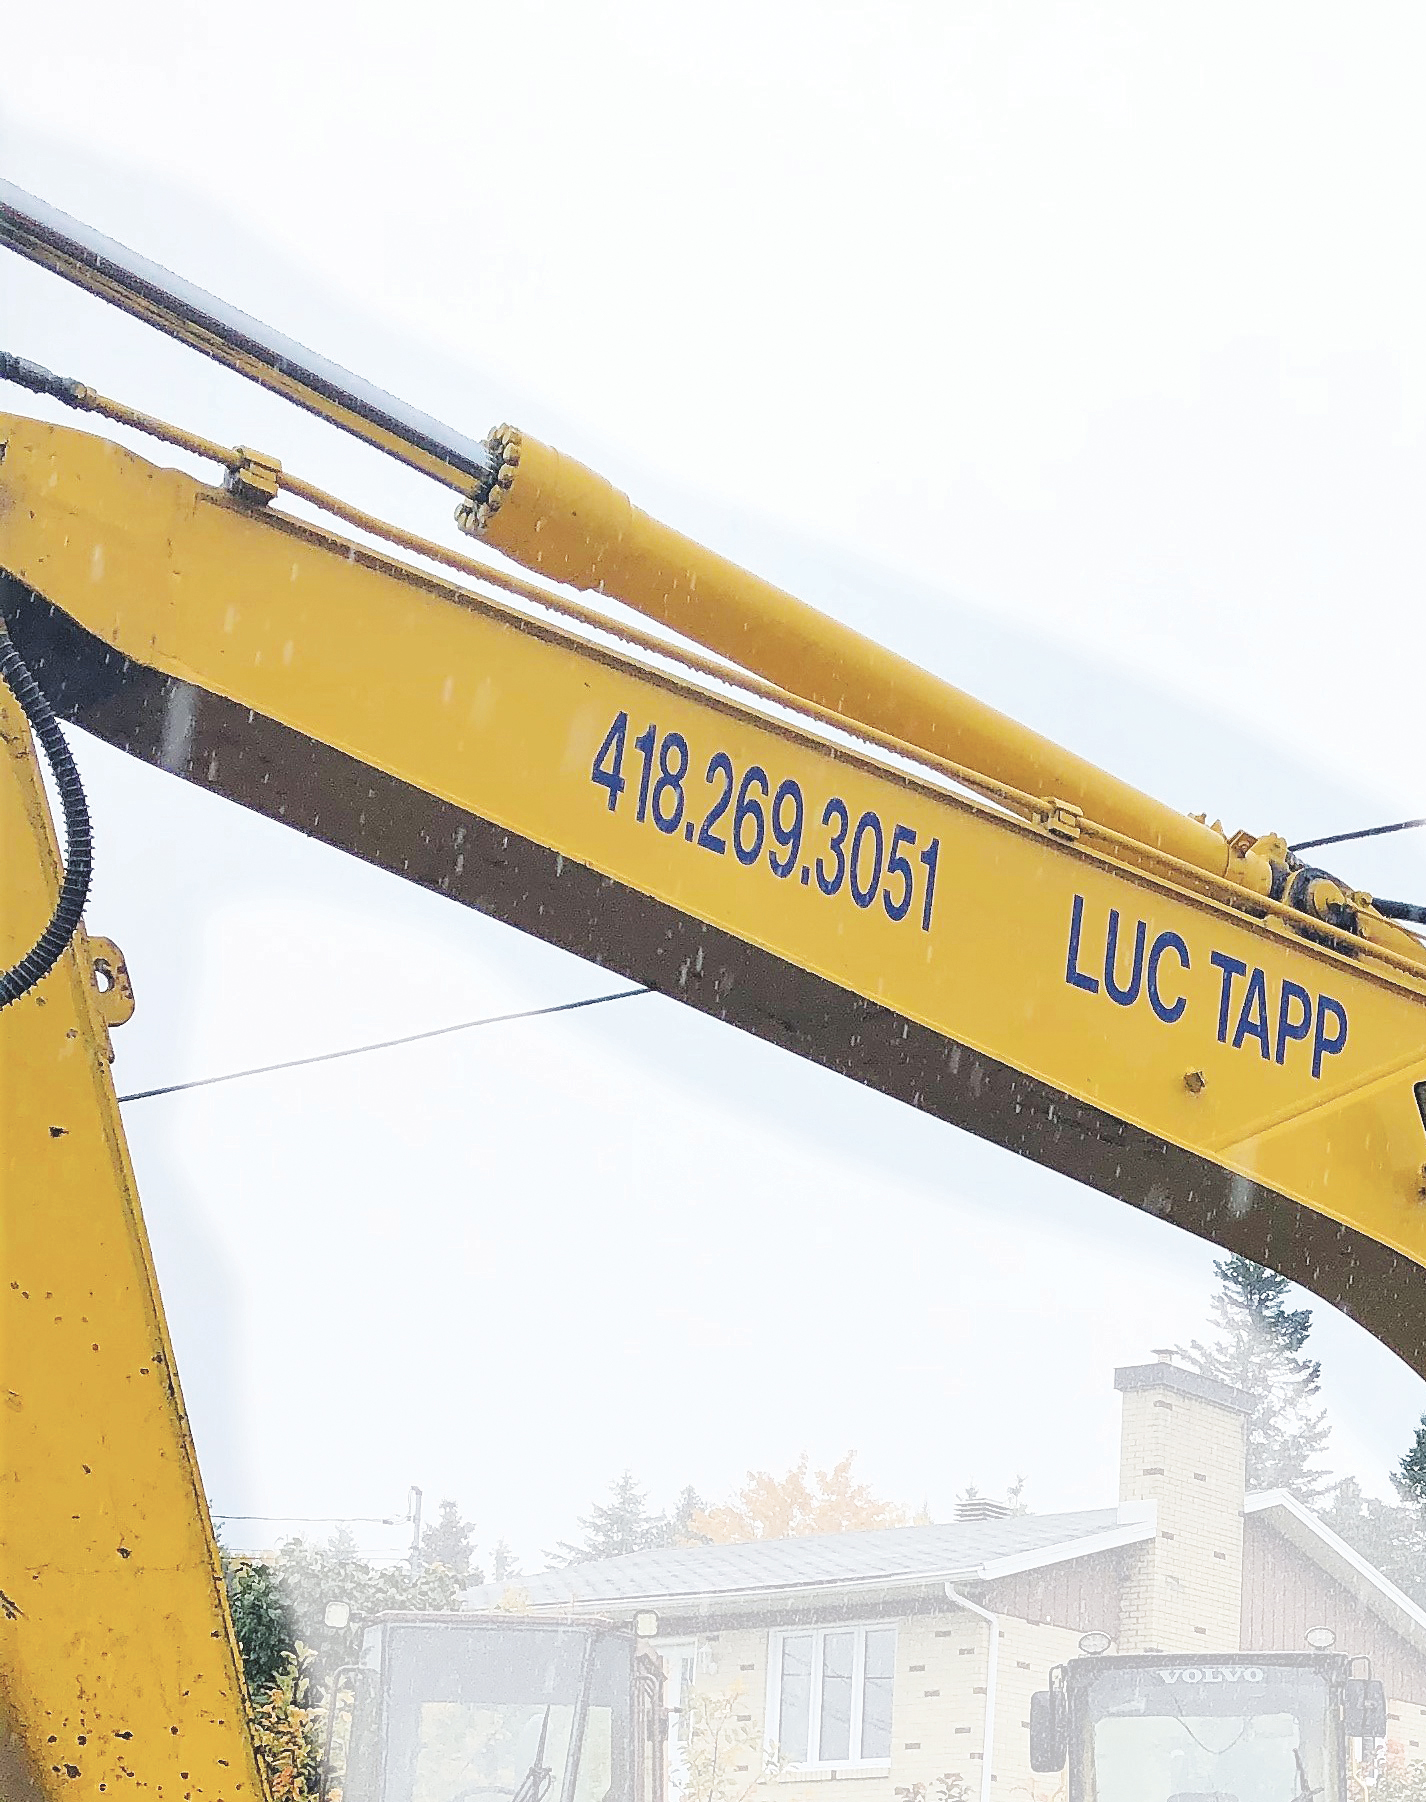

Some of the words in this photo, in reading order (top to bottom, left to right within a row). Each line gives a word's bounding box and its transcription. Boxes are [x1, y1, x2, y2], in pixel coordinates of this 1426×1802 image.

[591, 711, 940, 932] 418.269.3051
[1066, 894, 1190, 1023] LUC
[1210, 950, 1347, 1079] TAPP
[1156, 1668, 1263, 1683] VOLVO
